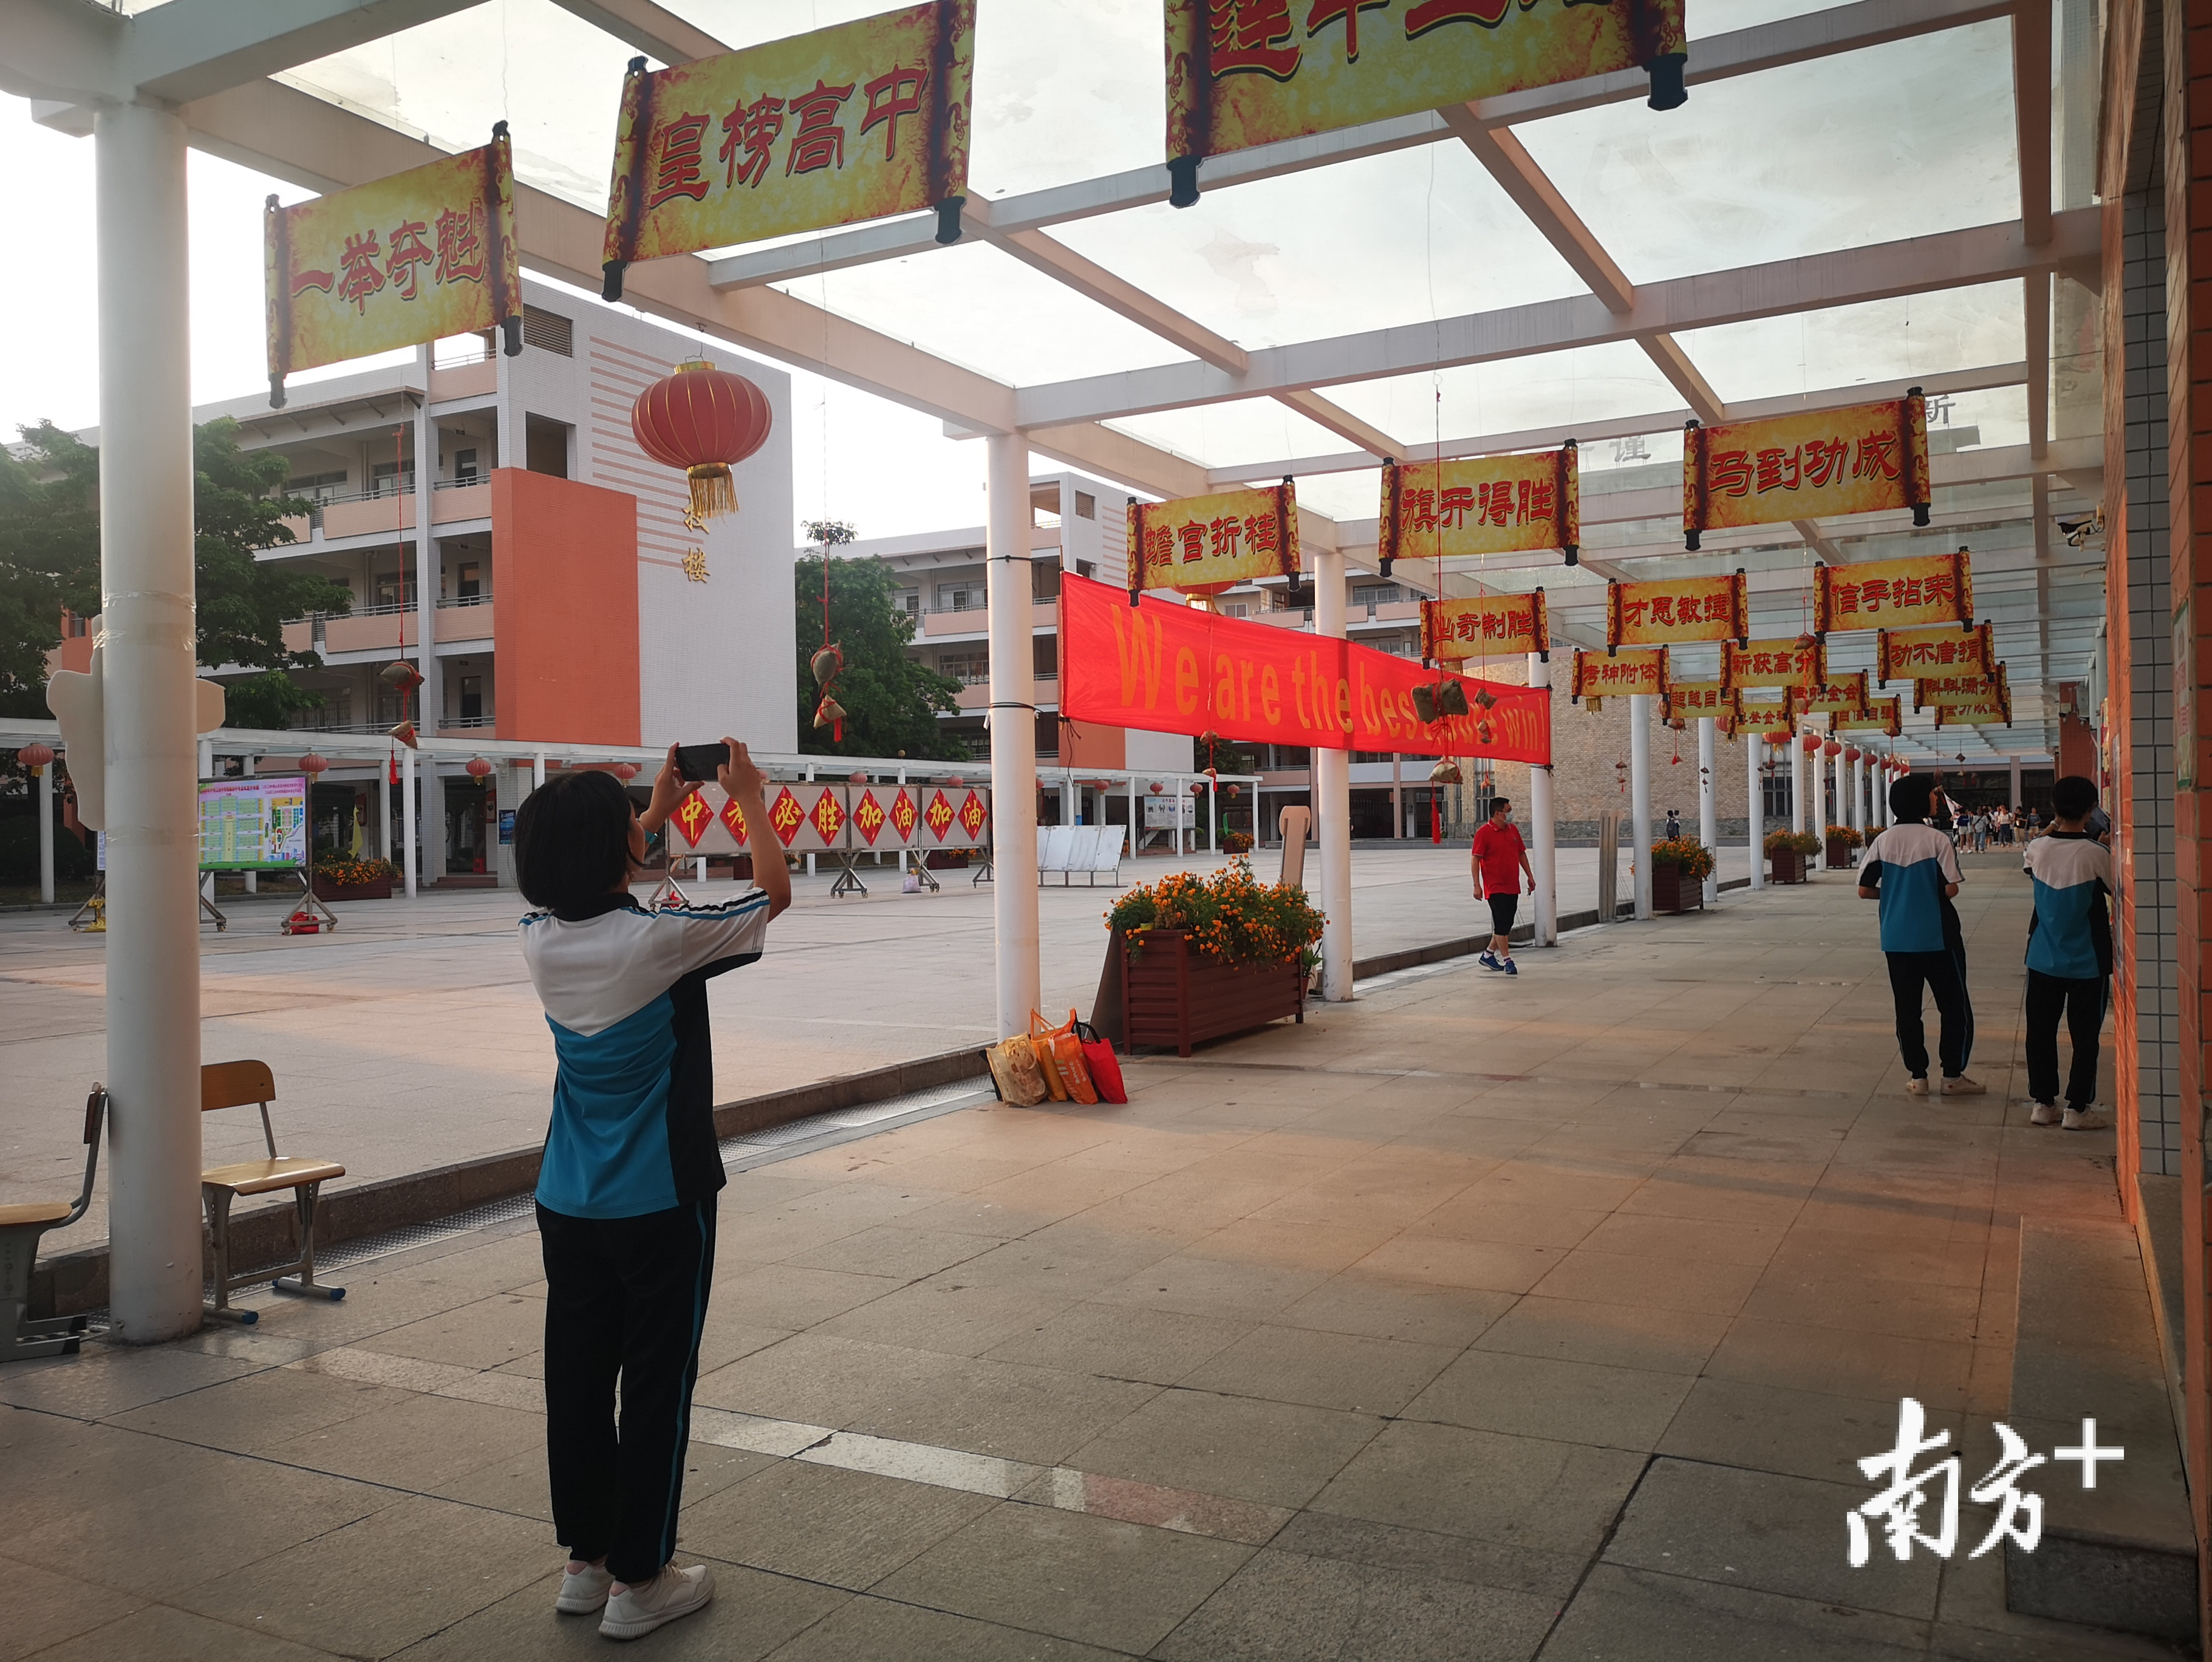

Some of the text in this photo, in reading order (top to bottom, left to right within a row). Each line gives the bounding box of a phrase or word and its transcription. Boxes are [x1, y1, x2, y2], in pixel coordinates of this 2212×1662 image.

[650, 63, 930, 209] 皇榜高中
[292, 201, 486, 315] 一举夺魁
[1708, 429, 1902, 498] 马到功成
[1401, 477, 1555, 533] 旗开得胜
[1145, 513, 1278, 567] 蟾宫折桂
[1623, 592, 1732, 629] 才思敏捷
[1831, 573, 1956, 615] 信手拈来
[1432, 609, 1535, 643] 出奇制胜
[1582, 662, 1658, 686] 考神附体
[1732, 651, 1816, 675] 斩获高分
[1891, 638, 1982, 667] 功不唐捐
[1110, 603, 1200, 716] We
[1215, 654, 1282, 726] are
[1291, 650, 1354, 734] the
[1500, 695, 1546, 753] win!
